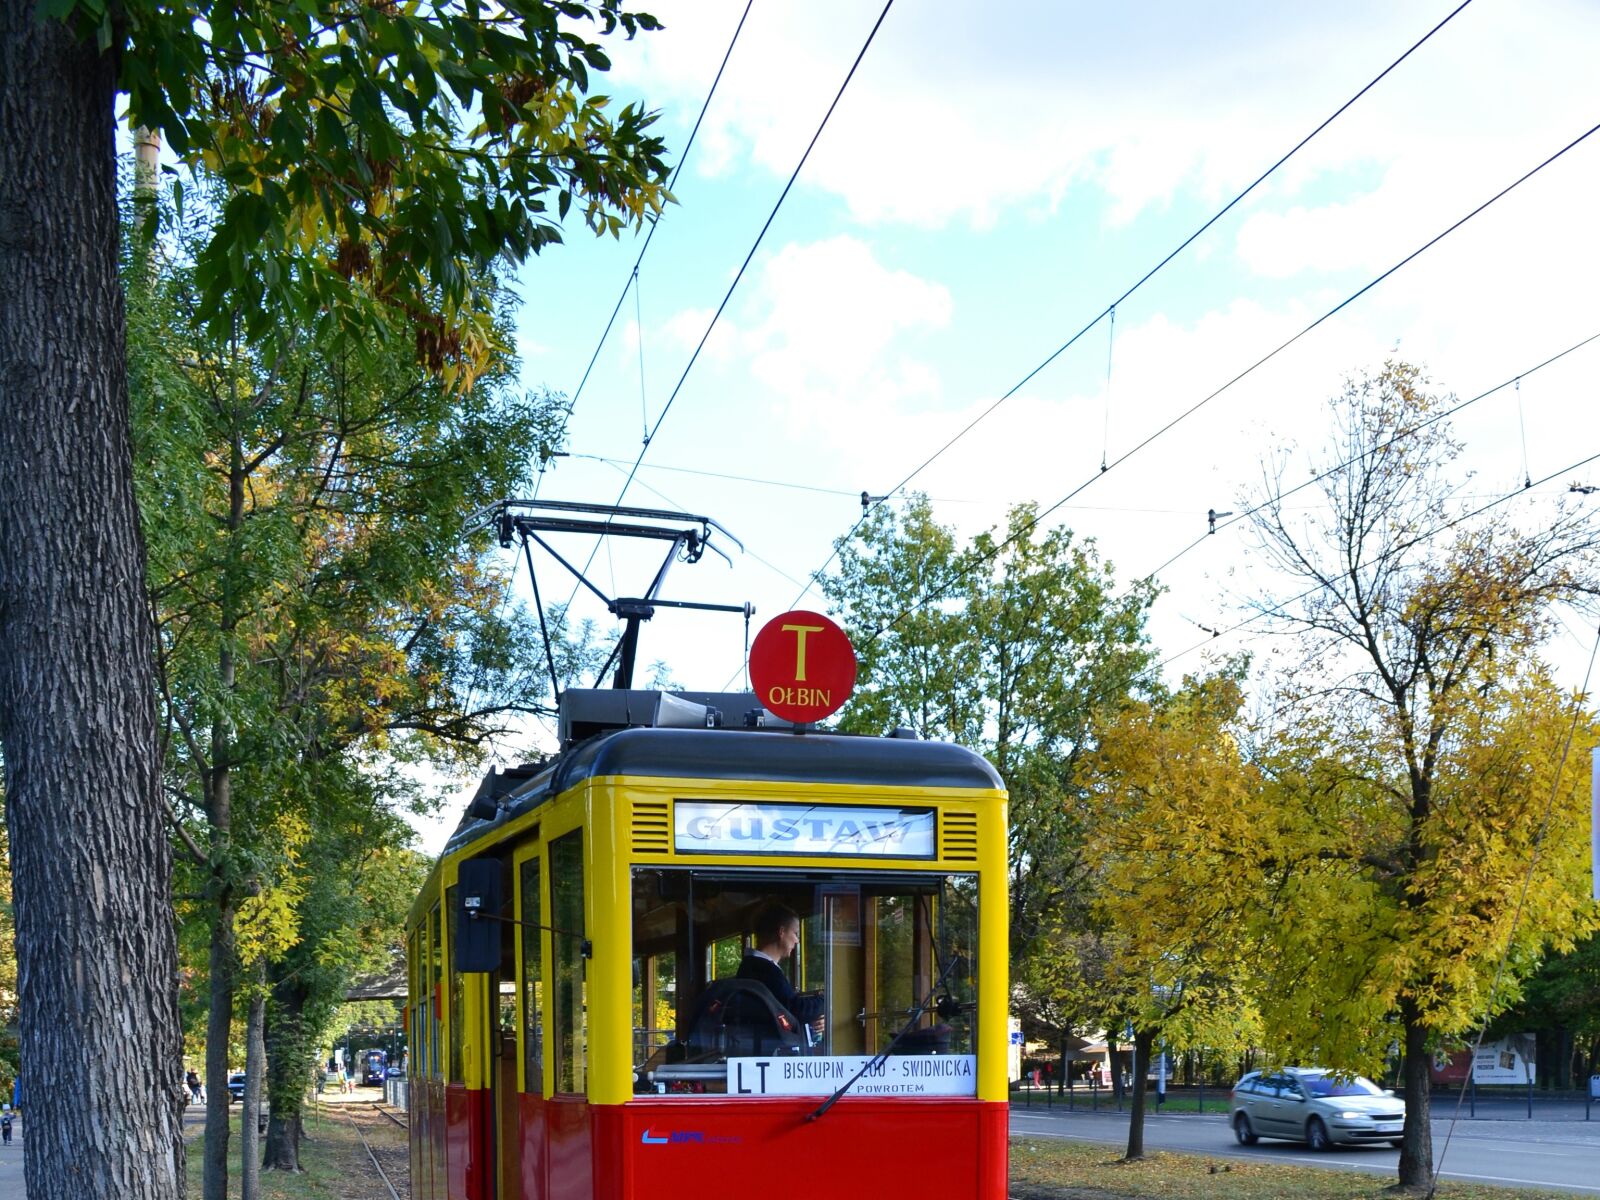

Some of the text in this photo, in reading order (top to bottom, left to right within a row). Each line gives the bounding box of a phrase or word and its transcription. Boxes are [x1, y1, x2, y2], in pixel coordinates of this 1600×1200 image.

[781, 624, 825, 681] T
[768, 686, 831, 707] OŁBIN
[686, 815, 913, 844] GUSTAW
[737, 1062, 770, 1094] LT
[784, 1061, 844, 1080] BISKUPIN
[857, 1084, 925, 1094] POWROTEM
